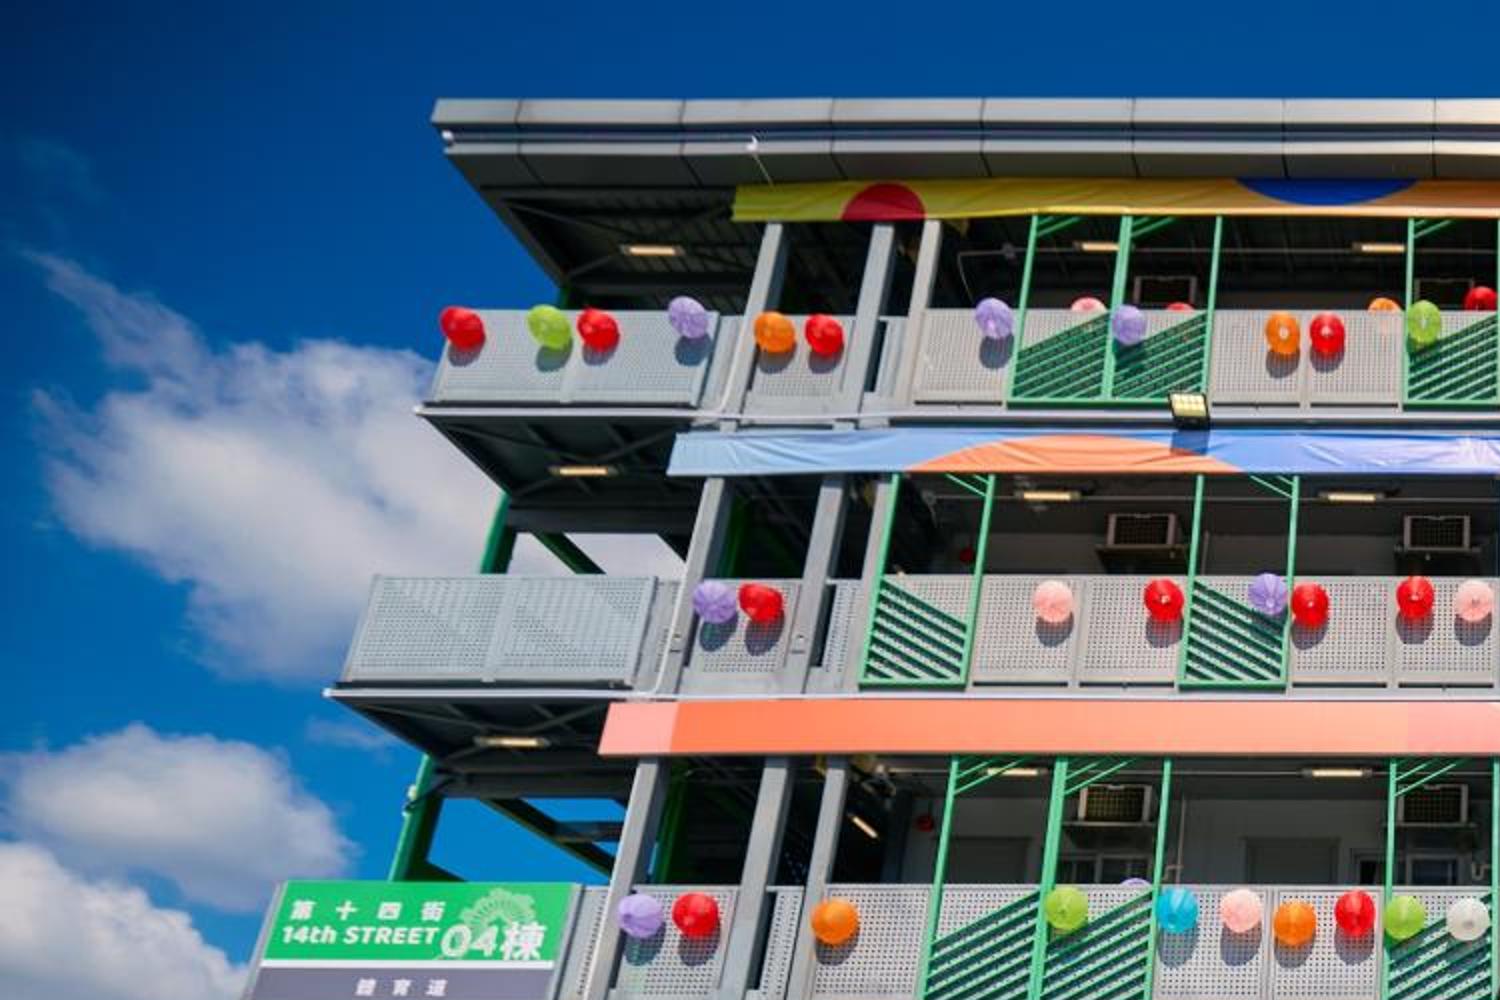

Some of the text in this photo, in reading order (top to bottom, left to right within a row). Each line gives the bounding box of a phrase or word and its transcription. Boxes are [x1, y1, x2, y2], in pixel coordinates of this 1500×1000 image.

[292, 901, 446, 920] 第十四街
[282, 926, 439, 945] 14th STREET
[441, 921, 545, 960] 04棟
